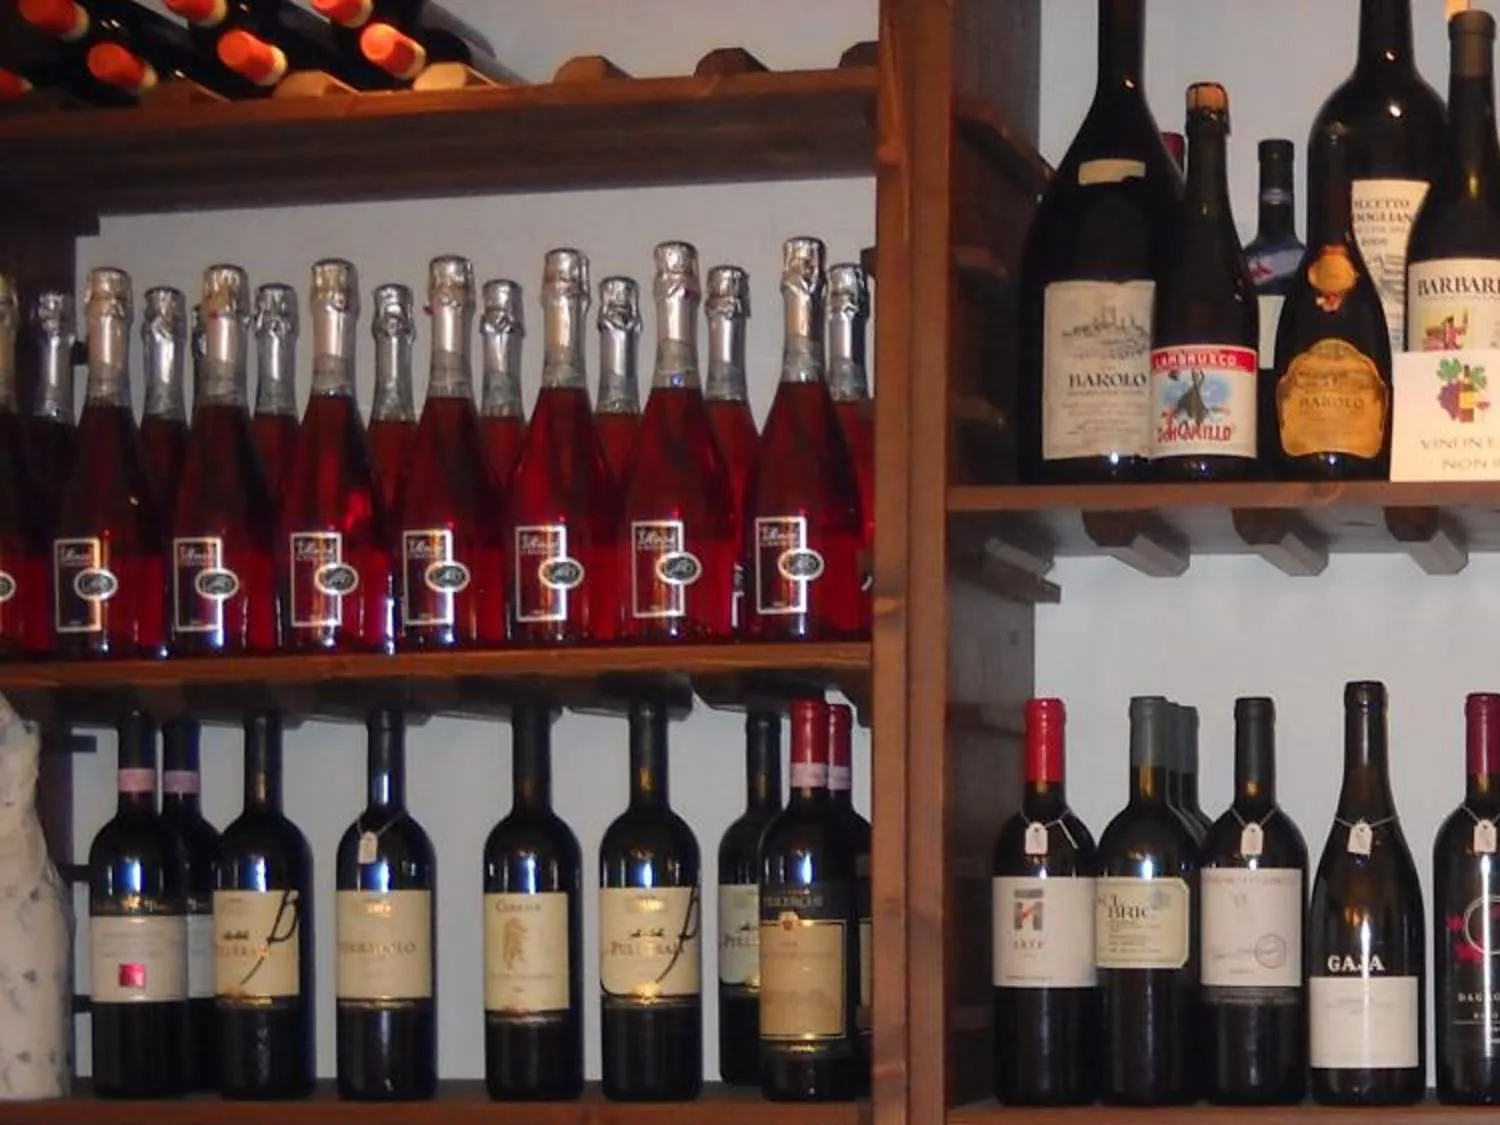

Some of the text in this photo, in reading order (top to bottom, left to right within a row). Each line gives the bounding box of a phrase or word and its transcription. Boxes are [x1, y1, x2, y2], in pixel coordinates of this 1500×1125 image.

[1154, 352, 1238, 368] LAMBRUSCO
[1068, 373, 1148, 388] BAROLO
[1299, 397, 1366, 410] BAROLO
[1420, 438, 1461, 450] VINI
[1463, 437, 1482, 449] IN
[1441, 457, 1488, 470] NON
